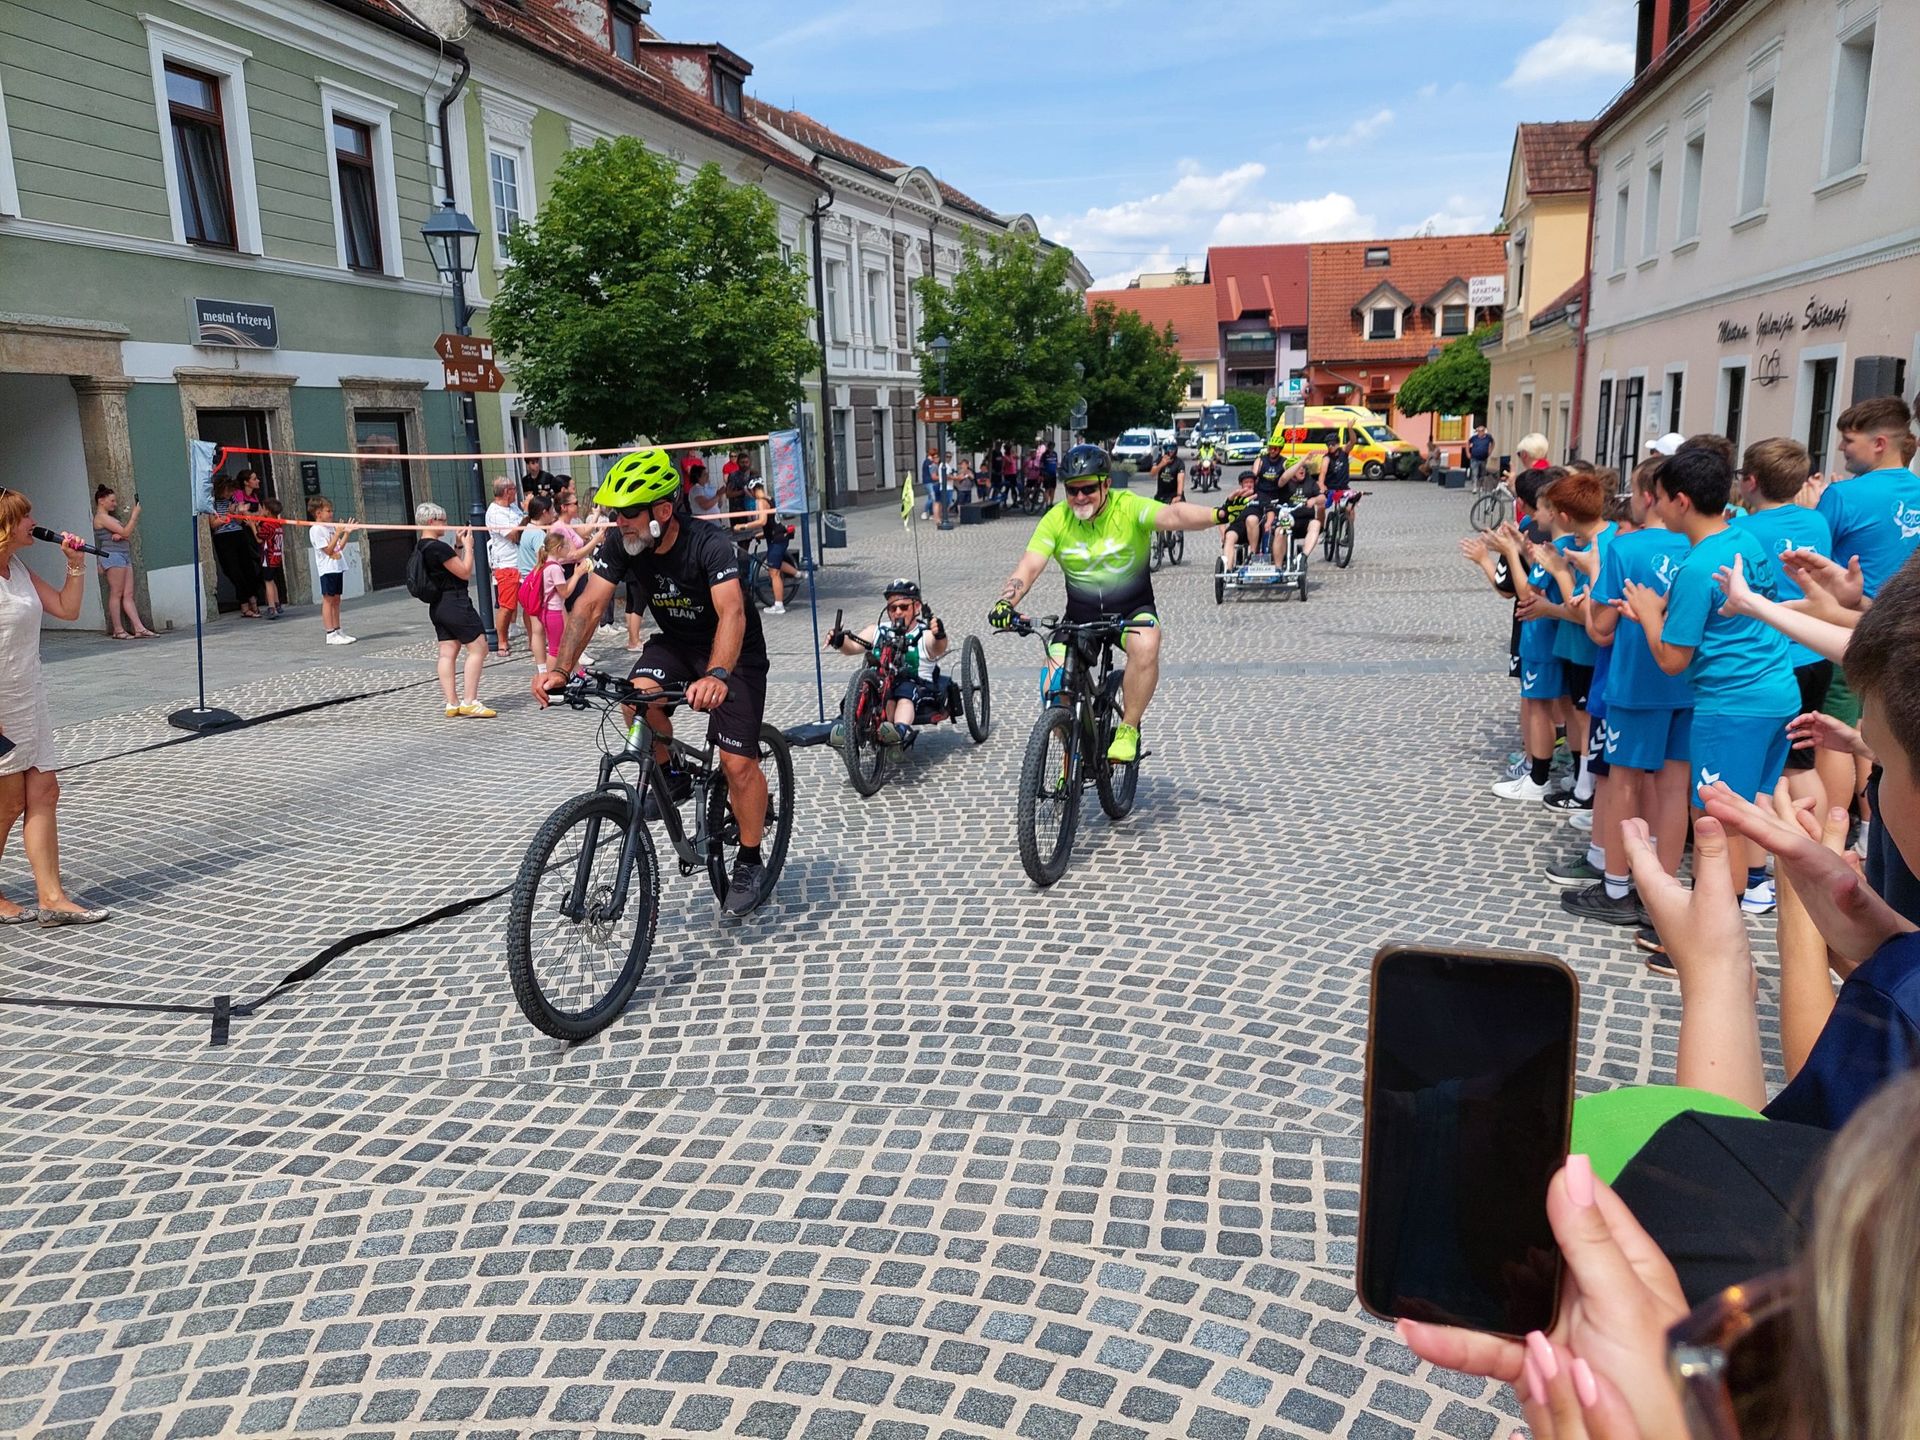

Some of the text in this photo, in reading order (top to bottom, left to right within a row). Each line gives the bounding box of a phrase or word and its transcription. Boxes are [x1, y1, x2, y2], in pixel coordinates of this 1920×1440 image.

[1801, 294, 1847, 331] Šoštanj
[203, 312, 271, 330] mestni frizeraj
[952, 398, 959, 408] P
[667, 607, 696, 620] TEAM
[722, 737, 742, 748] LELOSI
[647, 854, 657, 897] MARTELLO
